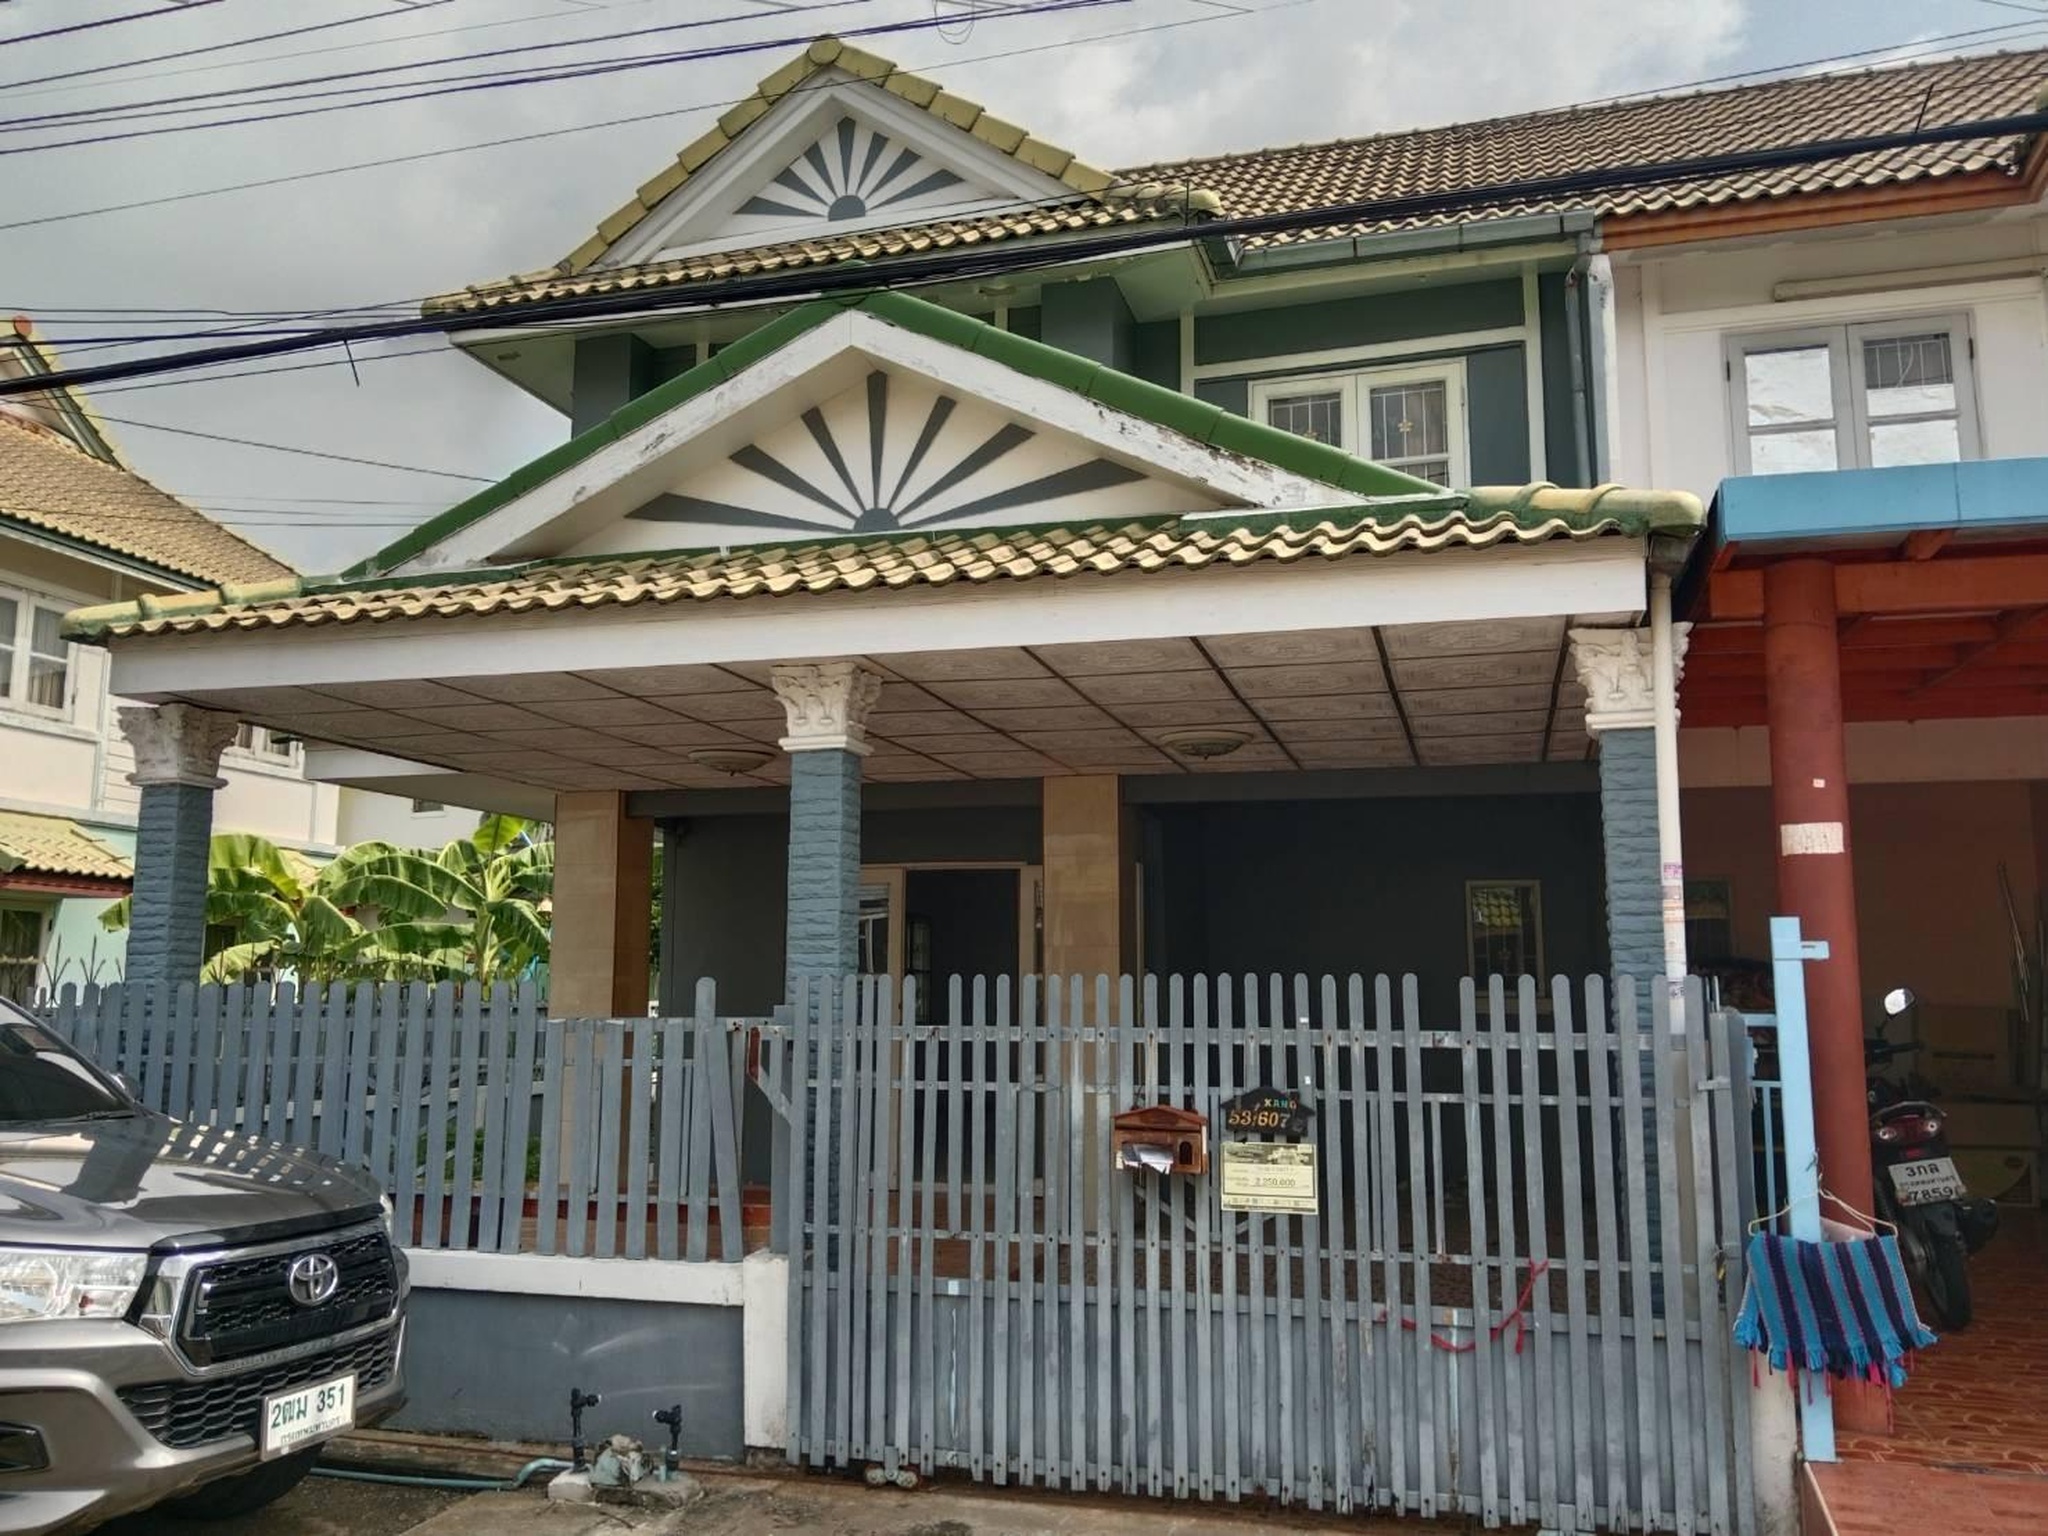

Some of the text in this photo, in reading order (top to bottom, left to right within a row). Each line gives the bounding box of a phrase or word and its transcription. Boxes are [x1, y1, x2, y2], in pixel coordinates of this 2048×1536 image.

[1905, 1163, 1939, 1177] 3กล
[1908, 1186, 1953, 1201] 7859
[317, 1383, 345, 1413] 351
